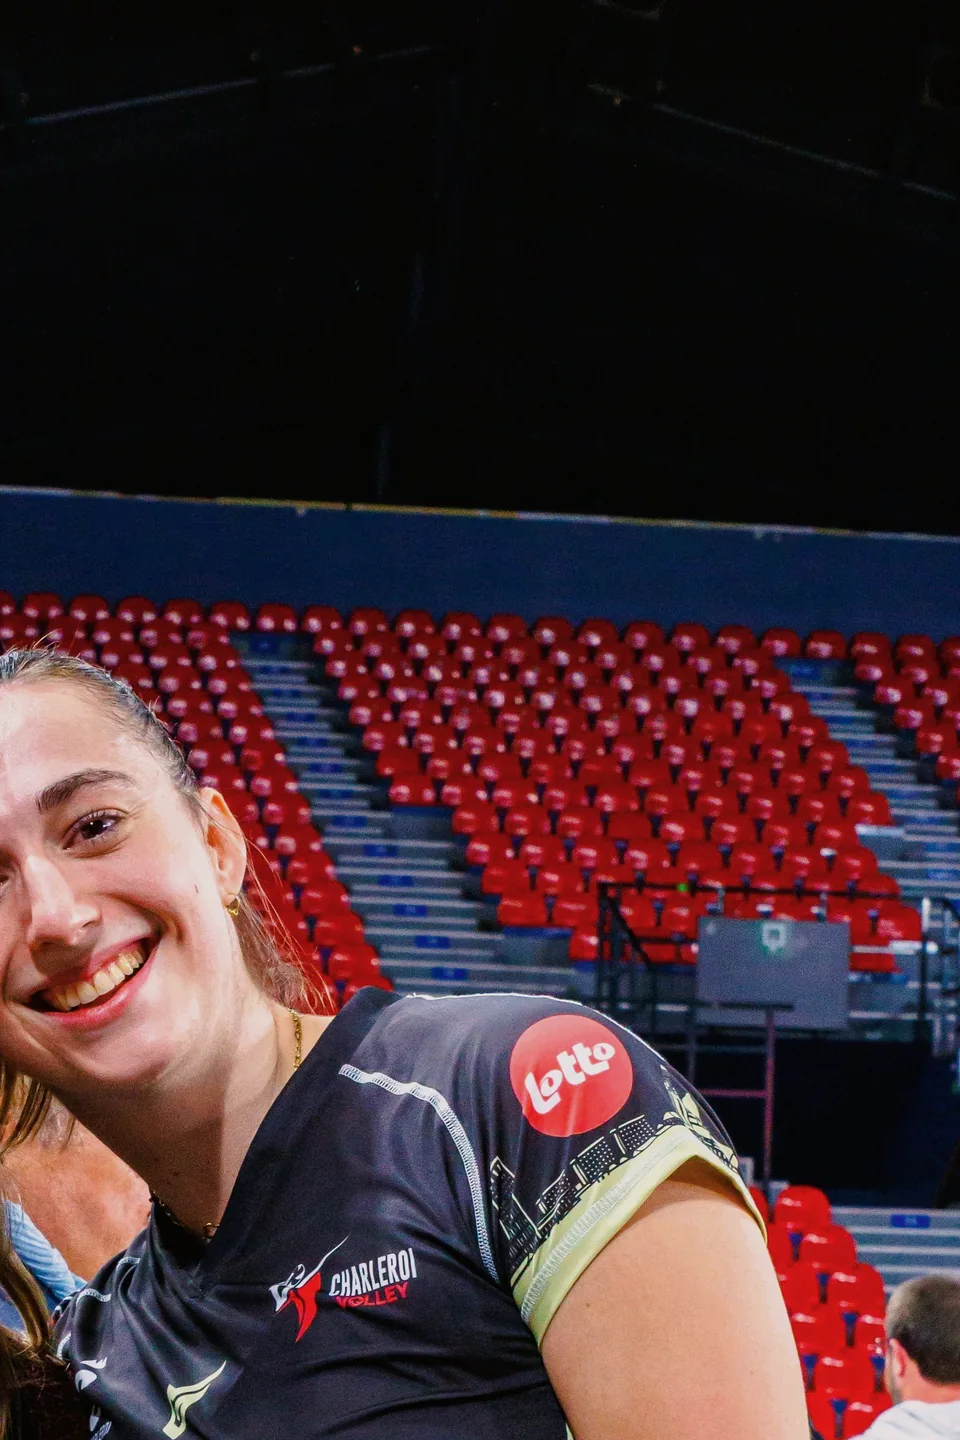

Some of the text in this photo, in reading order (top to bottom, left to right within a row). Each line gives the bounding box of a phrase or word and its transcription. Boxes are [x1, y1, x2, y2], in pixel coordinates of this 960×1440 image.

[524, 1041, 615, 1115] Lotto
[328, 1247, 417, 1296] CHARLEROI
[335, 1281, 409, 1309] VOLLEY
